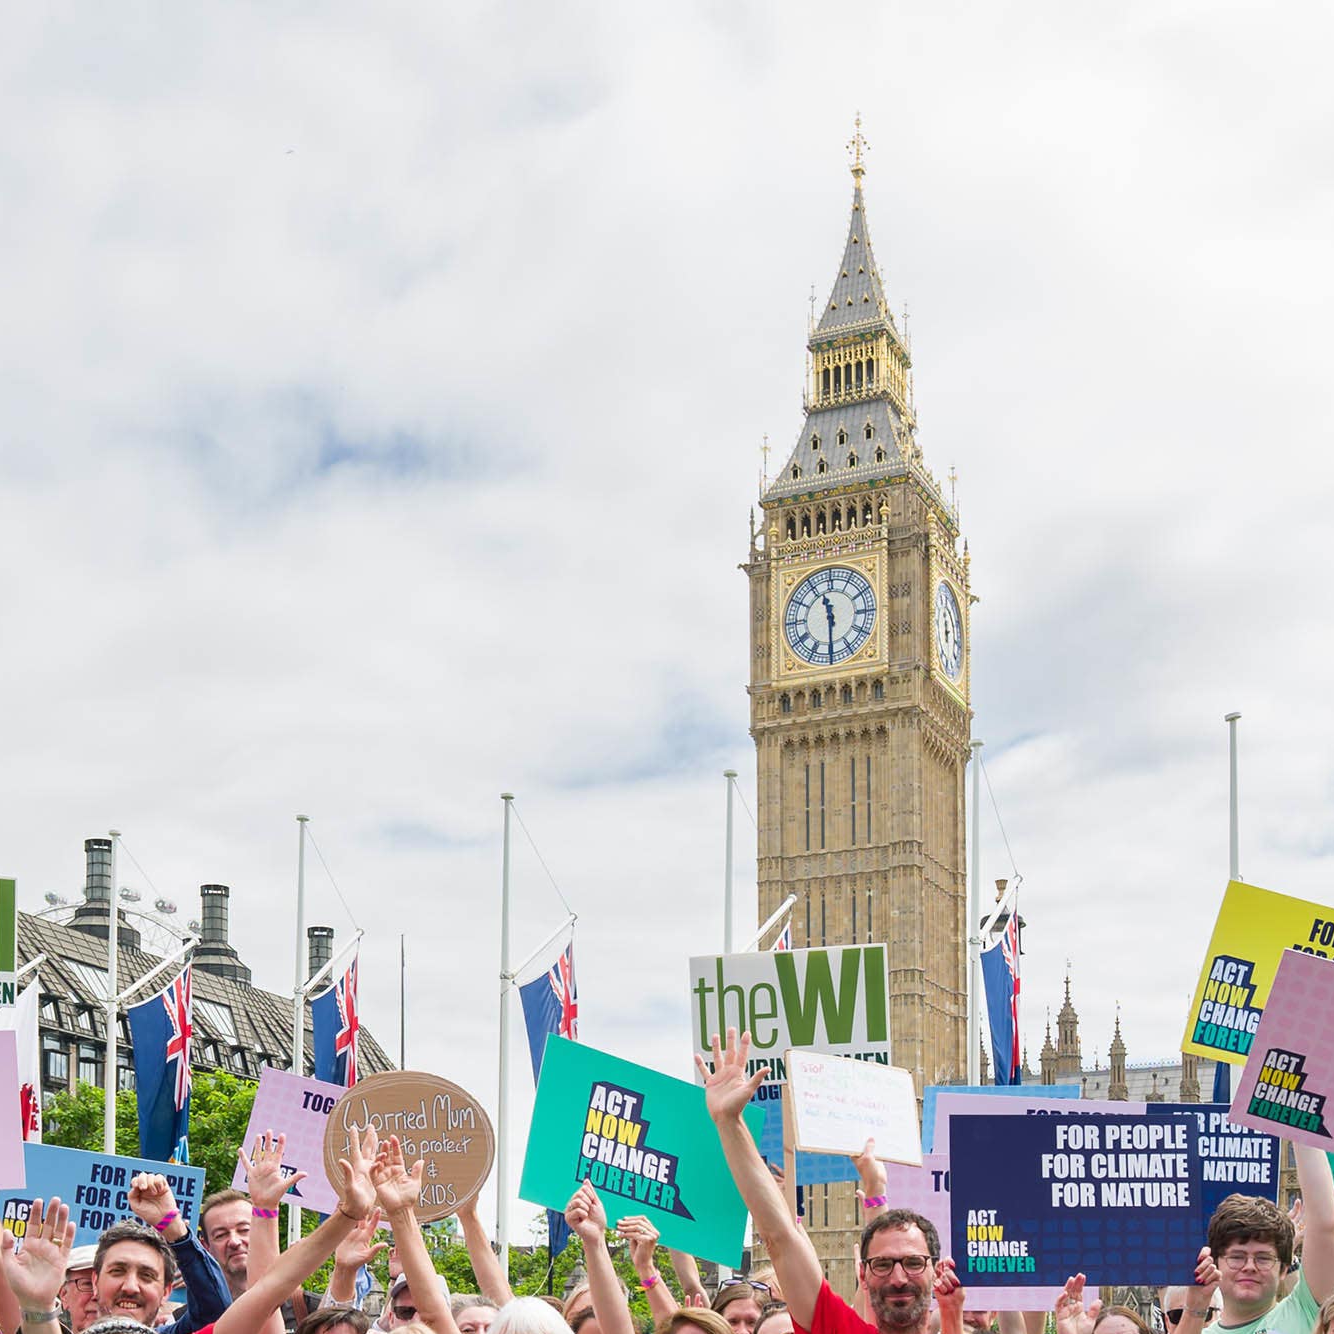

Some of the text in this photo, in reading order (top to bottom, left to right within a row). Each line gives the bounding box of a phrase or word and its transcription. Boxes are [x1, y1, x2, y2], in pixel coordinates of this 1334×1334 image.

[1210, 959, 1248, 986] ACT
[1205, 980, 1249, 1008] NOW
[1199, 1001, 1260, 1033] CHANG
[1193, 1021, 1255, 1050] FOREV
[1265, 1050, 1299, 1072] ACT
[1259, 1068, 1301, 1090] NOW
[590, 1085, 637, 1119] ACT
[1254, 1083, 1319, 1114] CHANGE
[343, 1100, 427, 1132] Worried
[433, 1094, 475, 1130] Mum
[1248, 1098, 1322, 1131] FOREVER
[586, 1109, 641, 1147] NOW
[1056, 1124, 1187, 1150] FOR PEOPLE
[420, 1132, 472, 1160] protect
[581, 1133, 671, 1184] CHANGE
[1198, 1136, 1271, 1159] CLIMATE
[91, 1164, 125, 1186] FOR
[1042, 1153, 1189, 1179] FOR CLIMATE
[1203, 1160, 1270, 1183] NATURE
[75, 1185, 111, 1207] FOR
[420, 1184, 456, 1207] KIDS
[578, 1157, 676, 1211] FOREVER
[1052, 1182, 1189, 1207] FOR NATURE
[5, 1202, 34, 1220] AC
[80, 1209, 115, 1230] FOR
[968, 1210, 997, 1226] ACT
[967, 1226, 1003, 1241] NOW
[967, 1241, 1028, 1257] CHANGE
[968, 1256, 1035, 1272] FOREVER
